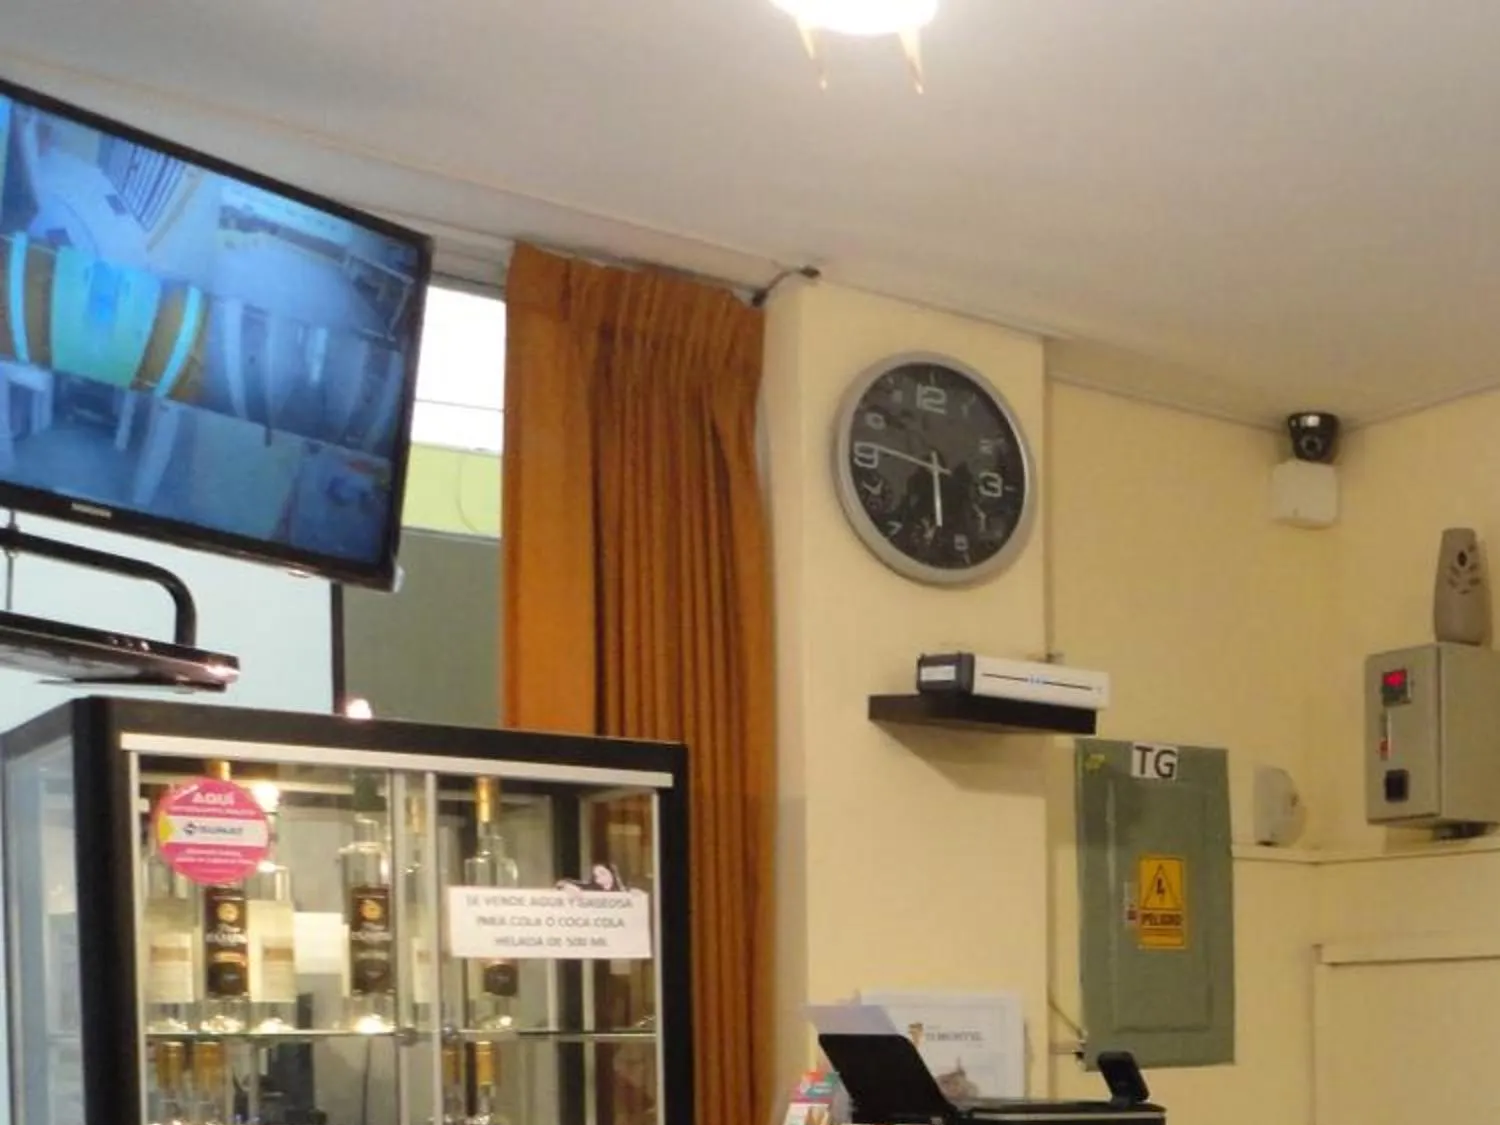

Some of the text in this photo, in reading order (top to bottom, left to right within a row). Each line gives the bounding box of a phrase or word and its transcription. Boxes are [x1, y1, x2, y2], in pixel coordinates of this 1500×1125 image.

[916, 384, 947, 414] 12
[978, 471, 1003, 498] 3
[1135, 745, 1177, 779] TG
